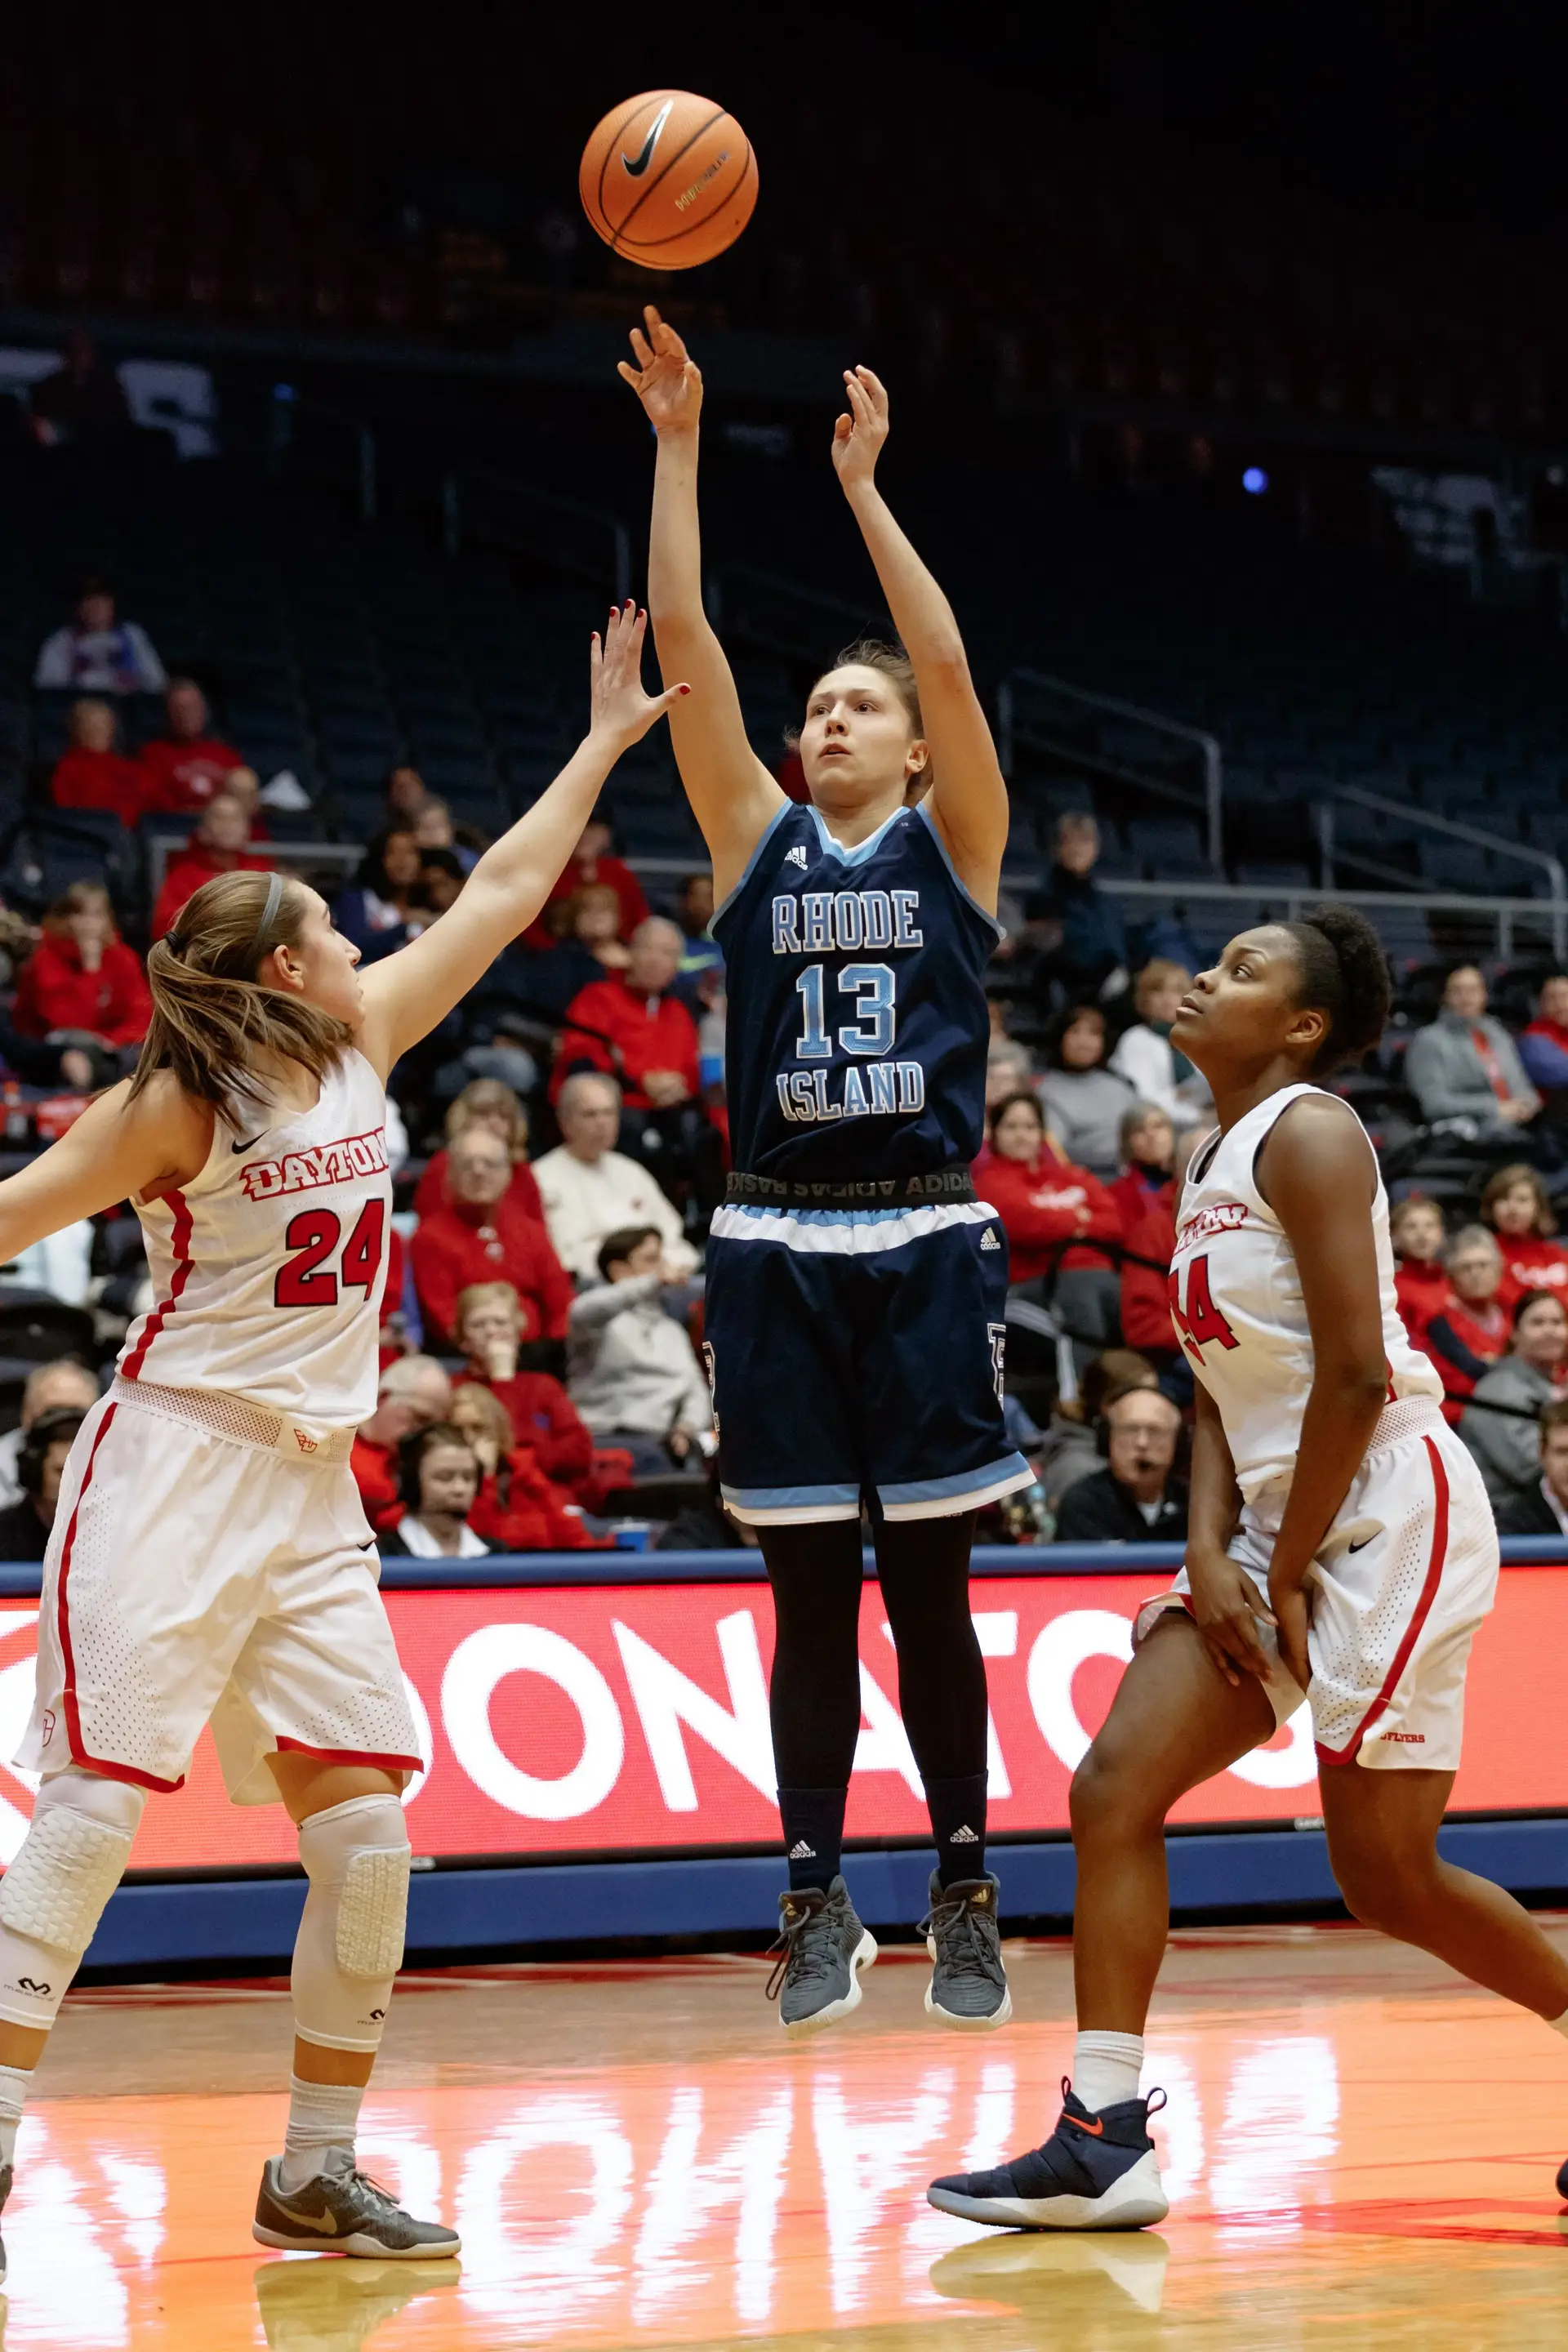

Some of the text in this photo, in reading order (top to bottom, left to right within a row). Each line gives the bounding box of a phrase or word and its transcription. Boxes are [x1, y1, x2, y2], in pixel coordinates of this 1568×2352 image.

[785, 852, 808, 871] adidas
[773, 890, 923, 954] RHODE
[796, 963, 896, 1058] 13
[777, 1062, 924, 1121] ISLAND
[238, 1125, 389, 1202] DAYTON
[274, 1197, 384, 1307] 24
[980, 1241, 1001, 1250] adidas
[789, 1850, 817, 1860] adidas
[950, 1834, 979, 1843] adidas
